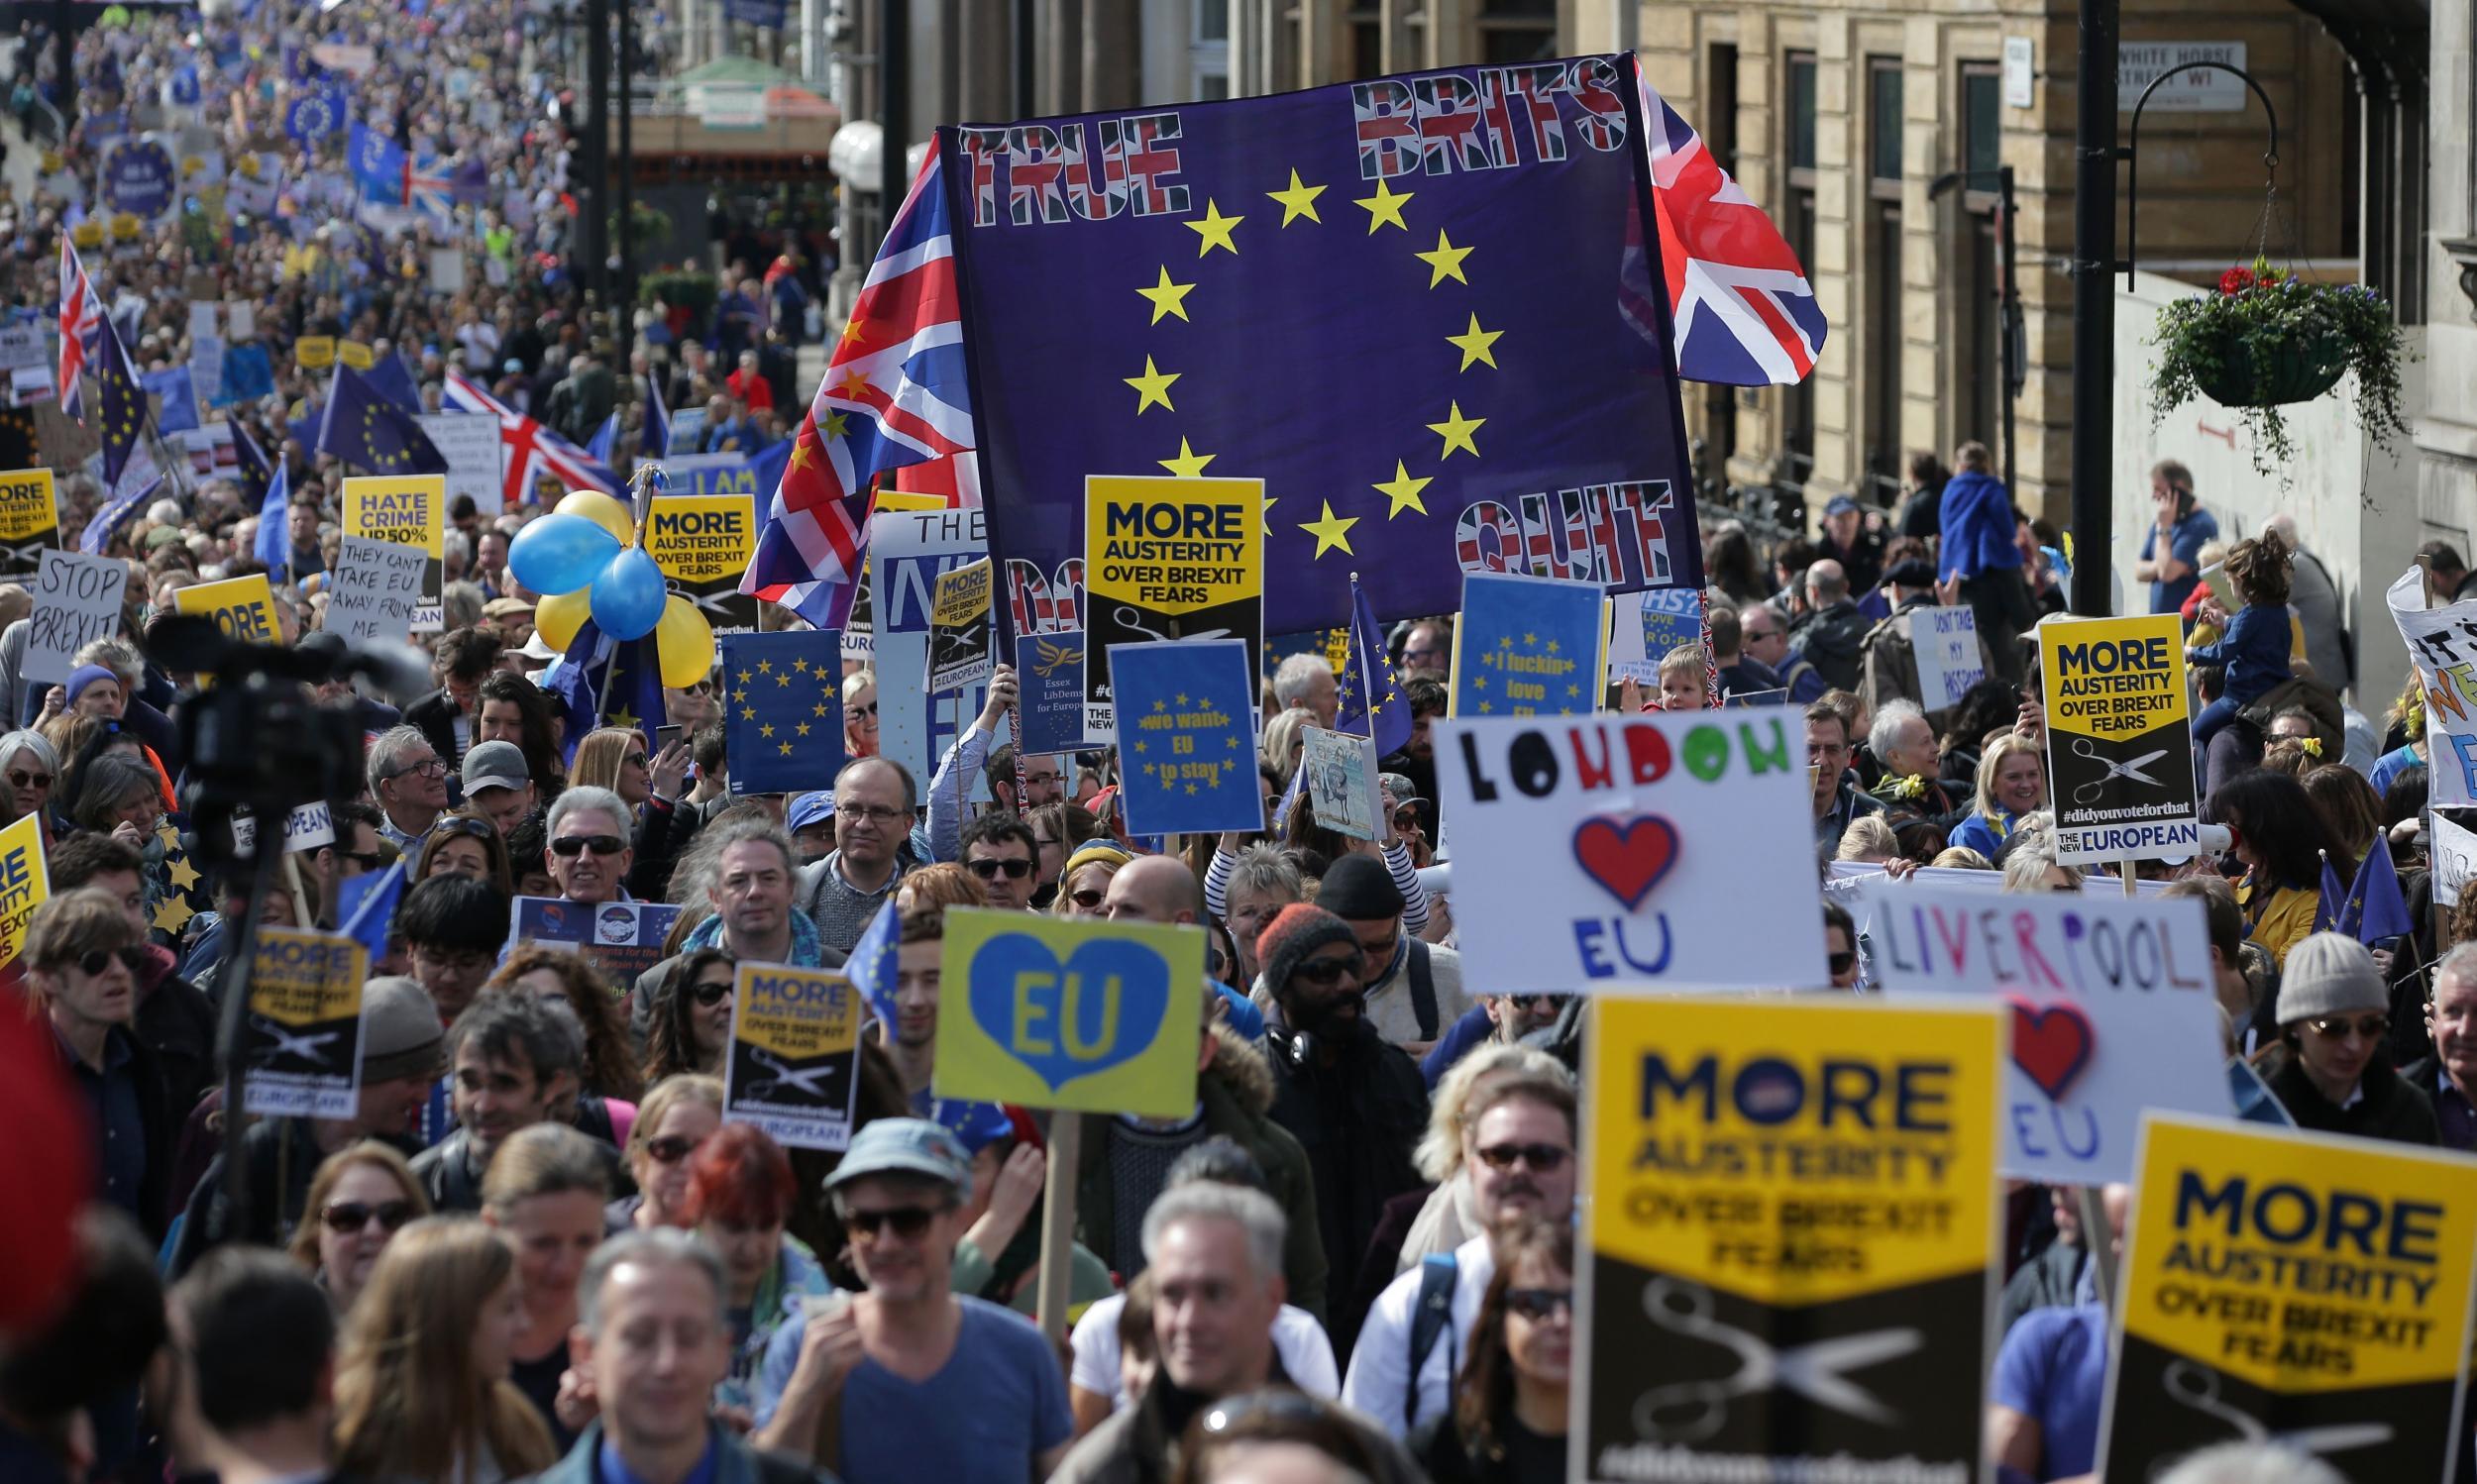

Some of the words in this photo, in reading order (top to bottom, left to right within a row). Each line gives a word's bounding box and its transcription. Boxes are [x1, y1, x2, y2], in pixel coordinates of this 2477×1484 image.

[2118, 48, 2168, 64] WHITE
[2177, 48, 2235, 64] HORSE
[1349, 56, 1628, 181] BRITS
[958, 111, 1192, 228] TRUE
[360, 492, 428, 511] HATE
[359, 510, 428, 528] CRIME
[654, 510, 743, 536] MORE
[914, 510, 988, 544] THE
[1106, 501, 1244, 540] MORE
[654, 534, 745, 551] AUSTERITY
[1454, 478, 1674, 586] QUIT
[345, 544, 383, 563] THEY
[654, 553, 694, 564] OVER
[696, 551, 746, 564] BREXIT
[1103, 540, 1245, 562] AUSTERITY
[42, 558, 121, 601] STOP
[338, 566, 379, 589] TAKE
[386, 572, 415, 591] EU
[678, 564, 722, 576] FEARS
[943, 566, 989, 596] MORE
[1102, 565, 1163, 583] OVER
[1167, 567, 1246, 584] BREXIT
[332, 589, 375, 611] AWAY
[377, 596, 413, 620] FROM
[936, 603, 959, 617] OVER
[958, 595, 988, 608] BREXIT
[941, 583, 987, 606] AUSTERITY
[1139, 586, 1209, 603] FEARS
[949, 608, 974, 622] FEARS
[1643, 611, 1674, 626] LOVE
[30, 604, 118, 655] BREXIT
[350, 619, 380, 639] ME
[1507, 651, 1563, 676] fuckin
[2057, 636, 2171, 677] MORE
[942, 662, 986, 686] EUROPEAN
[1045, 679, 1071, 689] Essex
[2059, 671, 2173, 697] AUSTERITY
[1506, 679, 1546, 700] love
[1037, 704, 1050, 713] for
[1088, 708, 1112, 720] THE
[2059, 697, 2109, 717] OVER
[2112, 693, 2175, 714] BREXIT
[1088, 720, 1114, 729] NEW
[1146, 714, 1173, 730] we
[1176, 710, 1222, 728] want
[2091, 713, 2147, 733] FEARS
[1172, 735, 1195, 755] EU
[1159, 763, 1177, 780] to
[1181, 761, 1219, 780] stay
[1457, 715, 1791, 803] LONDON
[2063, 800, 2191, 825] #didyouvoteforthat
[2059, 833, 2079, 844] THE
[2059, 843, 2082, 854] NEW
[2083, 822, 2199, 852] EUROPEAN
[255, 940, 353, 971] MORE
[1572, 911, 1673, 980] EU
[1881, 898, 2206, 991] LIVERPOOL
[751, 975, 848, 1008] MORE
[745, 1018, 788, 1033] OVER
[1013, 970, 1123, 1063] EU
[1638, 1047, 1956, 1134] MORE
[2010, 1102, 2101, 1162] EU
[1631, 1133, 1952, 1184] AUSTERITY
[1624, 1186, 1765, 1226] OVER
[2173, 1167, 2445, 1266] MORE
[2160, 1239, 2437, 1309] AUSTERITY
[2154, 1283, 2272, 1325] OVER
[2282, 1300, 2436, 1352] BREXIT
[2223, 1331, 2355, 1375] FEARS
